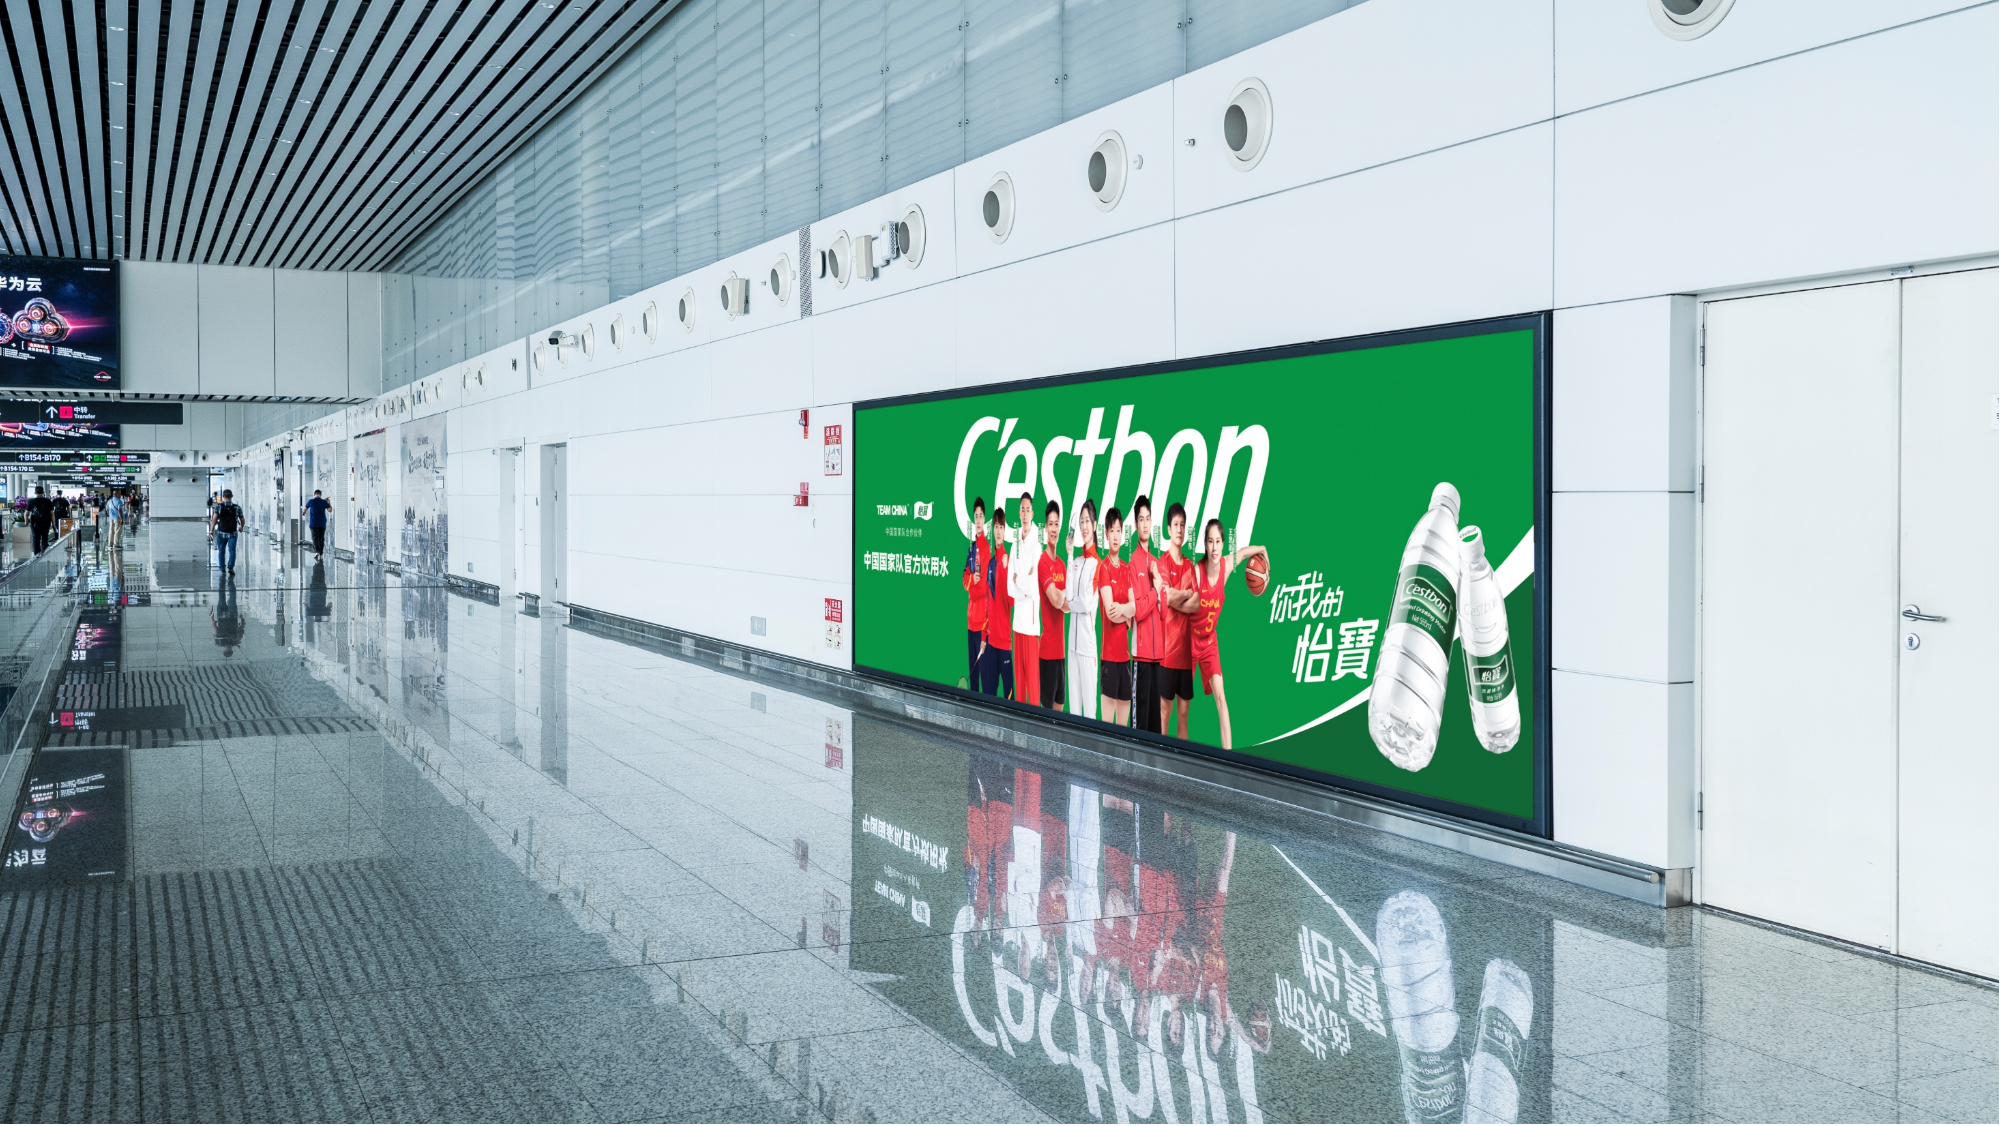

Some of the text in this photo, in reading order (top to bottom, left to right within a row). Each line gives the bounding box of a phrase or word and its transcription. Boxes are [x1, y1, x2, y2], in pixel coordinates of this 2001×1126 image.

[24, 454, 61, 462] B154-B170
[876, 504, 908, 516] TEAM CHINA
[885, 527, 922, 538] 中国国家队合作伙伴
[863, 550, 949, 578] 中国国家队官方饮用水
[1200, 599, 1220, 608] CHINA
[1269, 570, 1344, 624] 你我的
[1205, 612, 1217, 633] 5
[1291, 617, 1379, 683] 怡寶
